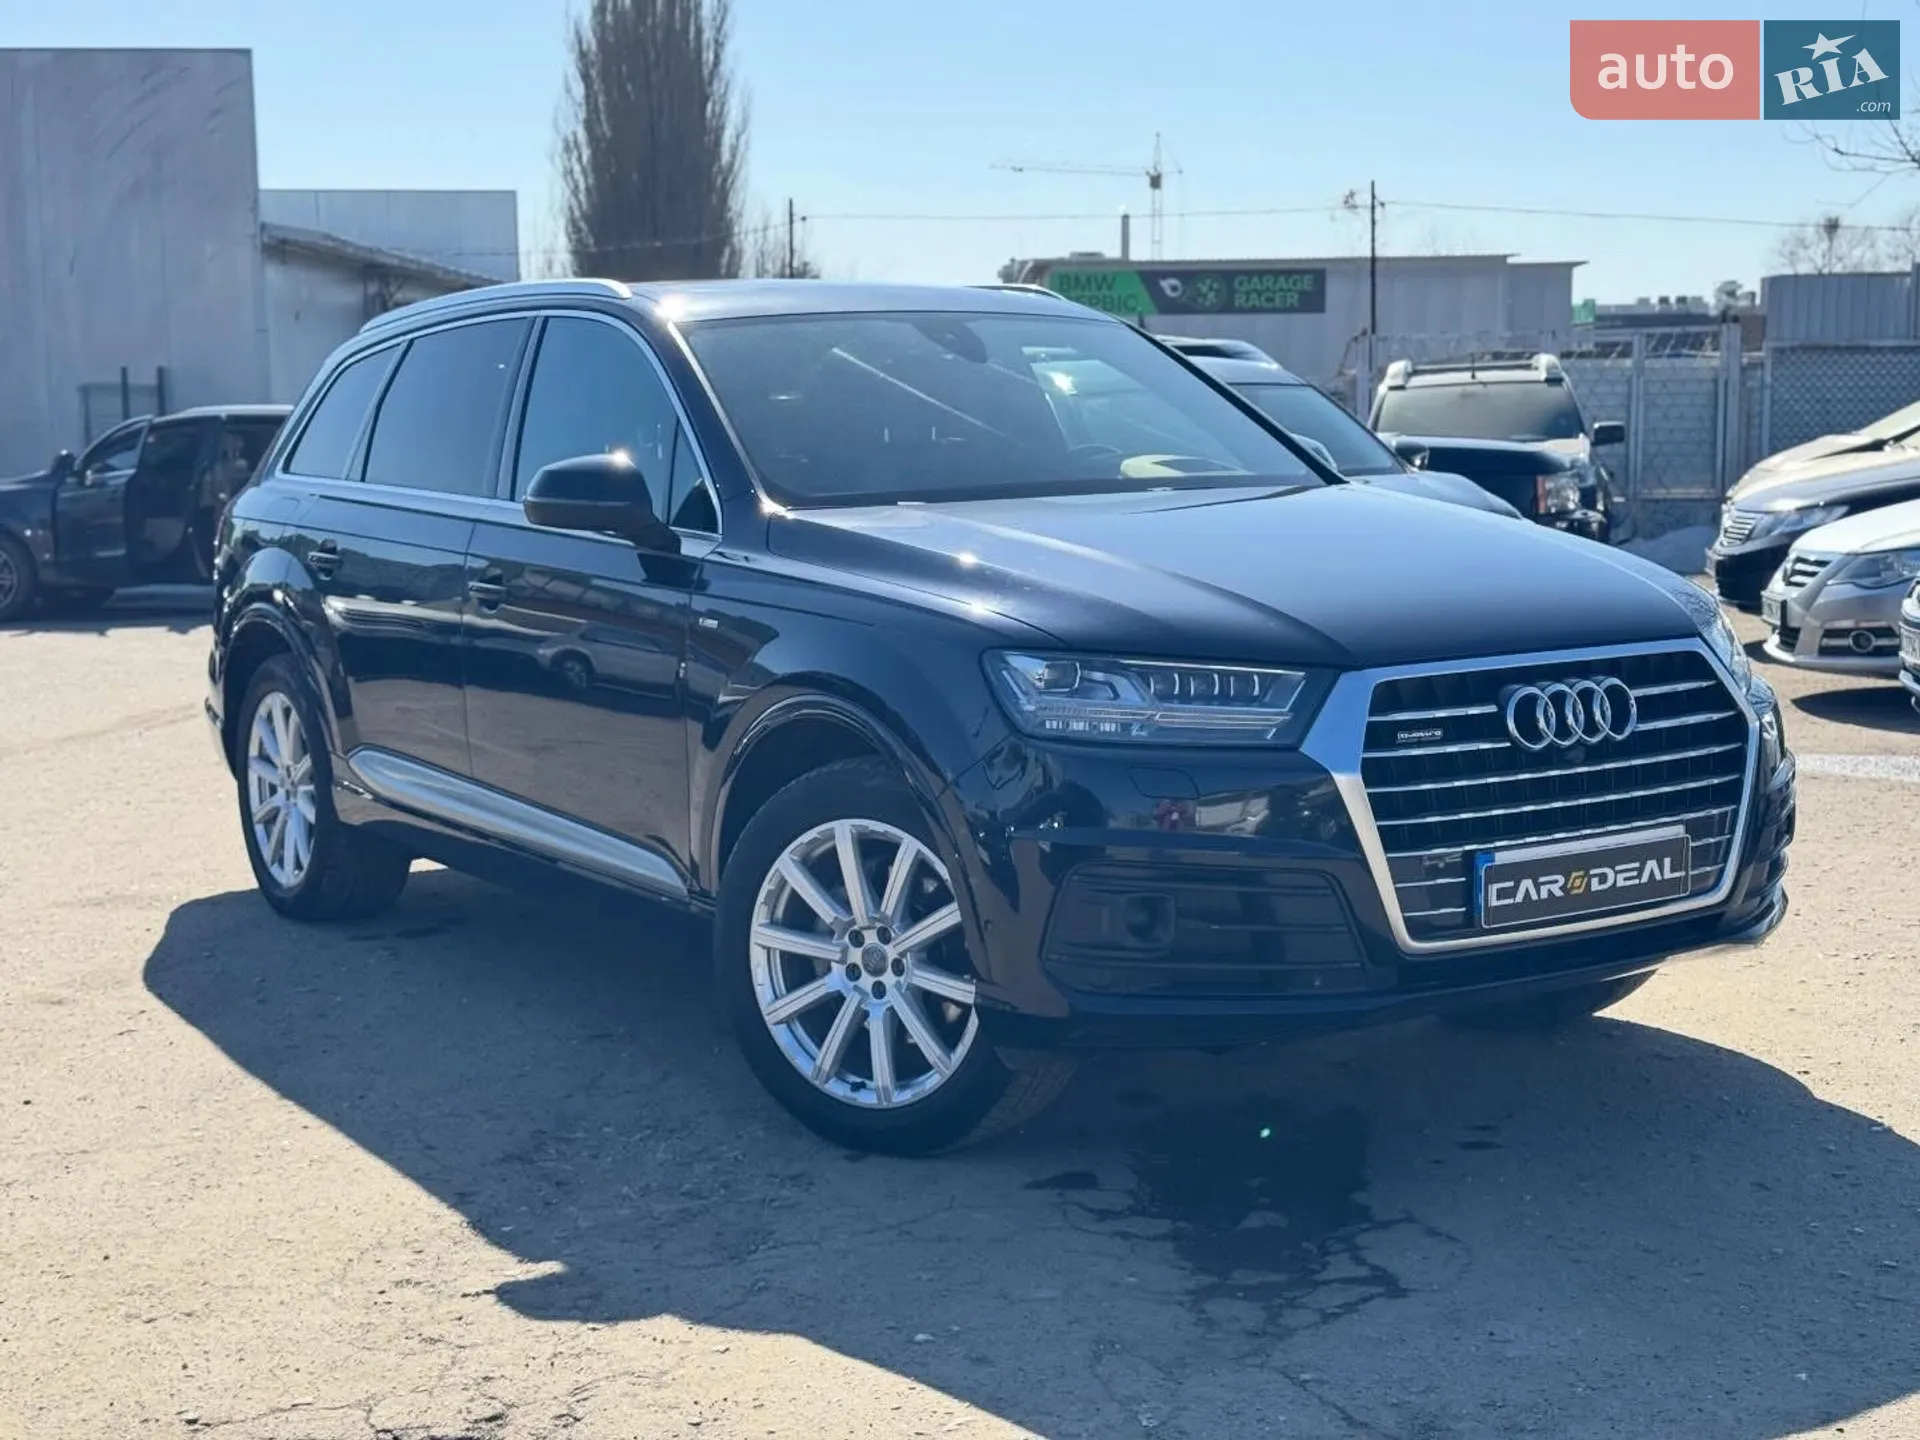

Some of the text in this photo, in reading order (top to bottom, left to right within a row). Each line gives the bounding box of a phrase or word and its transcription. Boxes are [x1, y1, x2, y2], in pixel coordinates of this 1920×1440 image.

[1058, 273, 1116, 293] BMW
[1234, 275, 1314, 291] GARAGE
[1234, 291, 1300, 309] RACER
[1488, 857, 1686, 907] CAR DEAL
